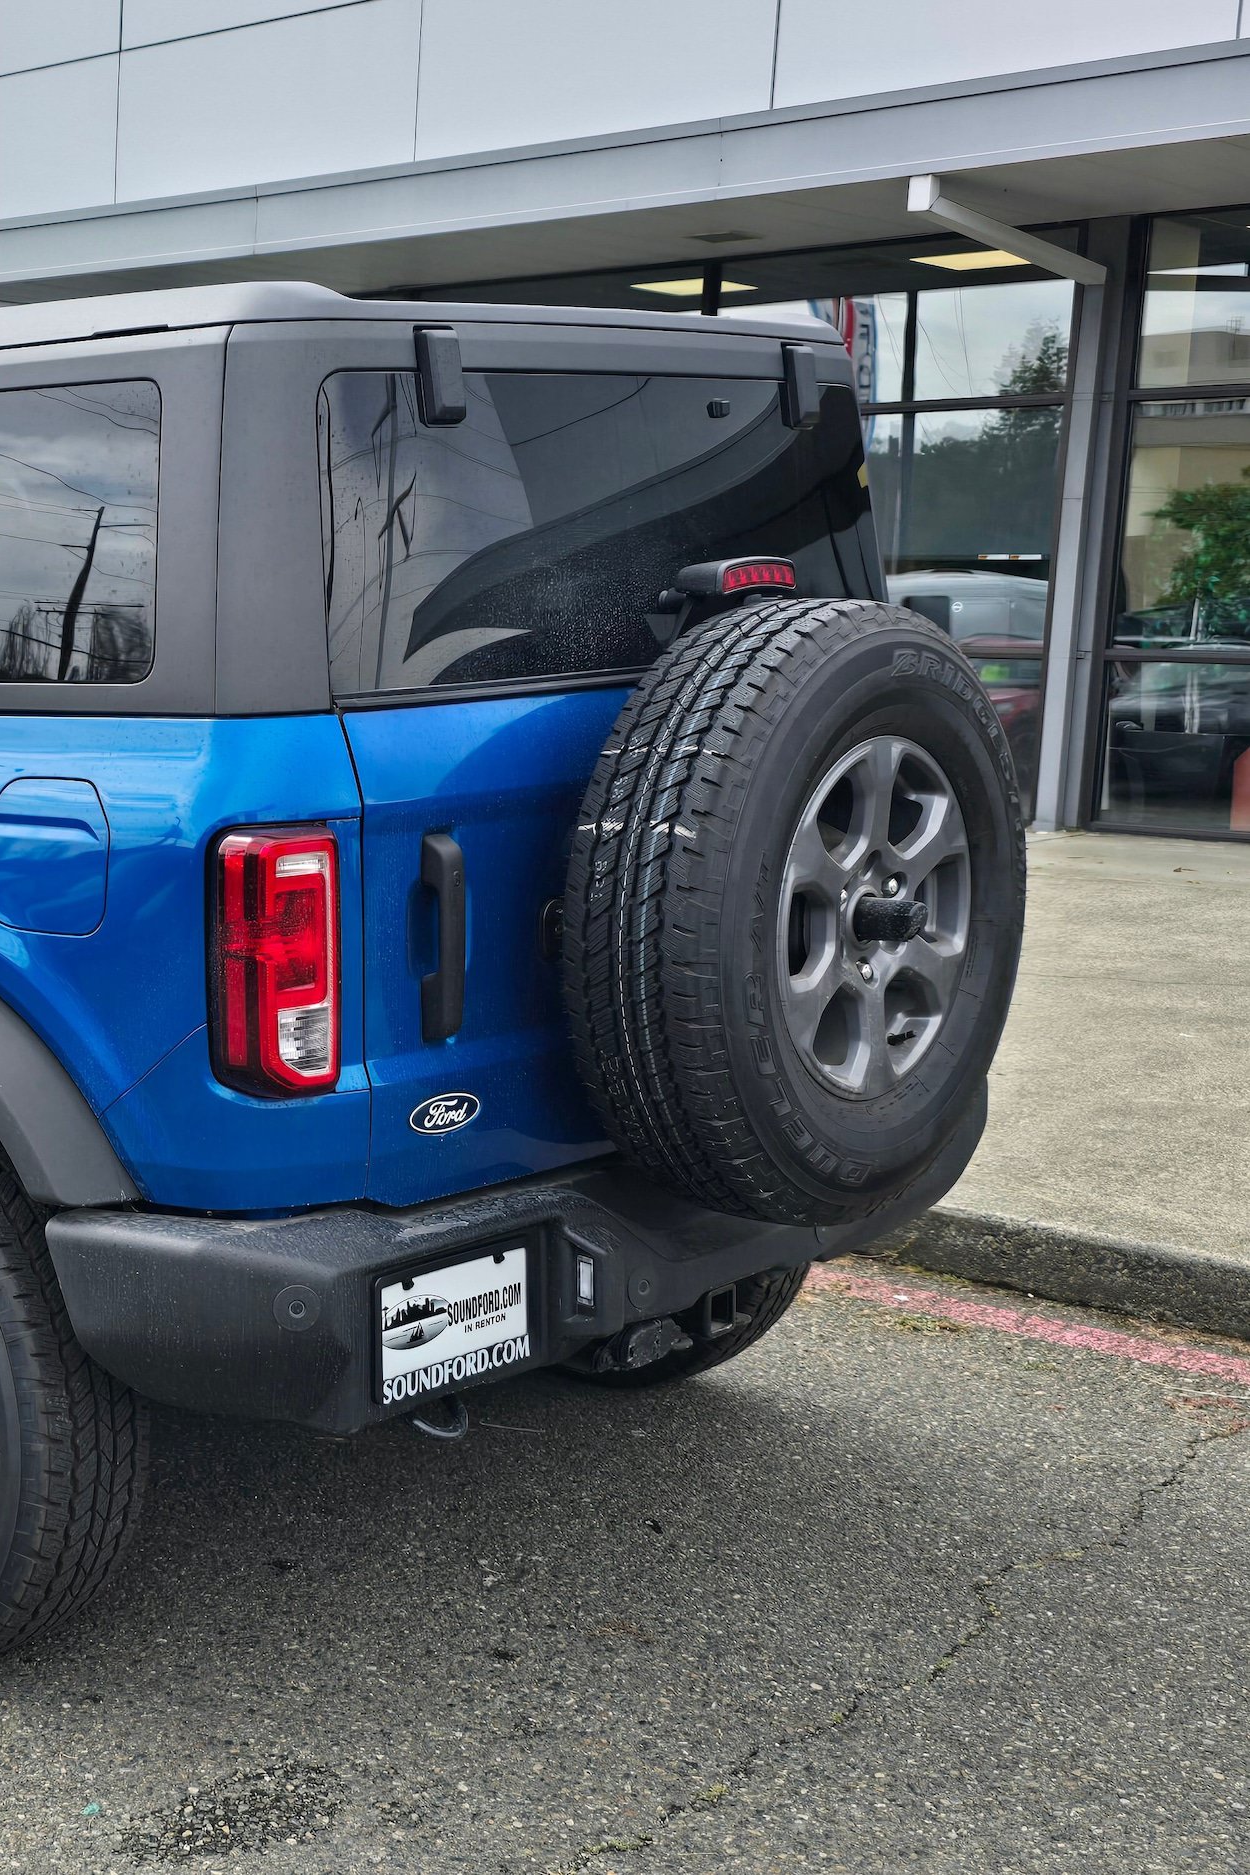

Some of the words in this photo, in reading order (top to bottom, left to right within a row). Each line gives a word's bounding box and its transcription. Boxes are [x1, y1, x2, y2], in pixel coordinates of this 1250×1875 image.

[423, 1098, 469, 1128] Ford
[447, 1282, 522, 1327] SOUNDFORD.COM
[464, 1323, 473, 1334] IN
[475, 1312, 506, 1331] RENTON
[382, 1333, 531, 1405] SOUNDFORD.COM
